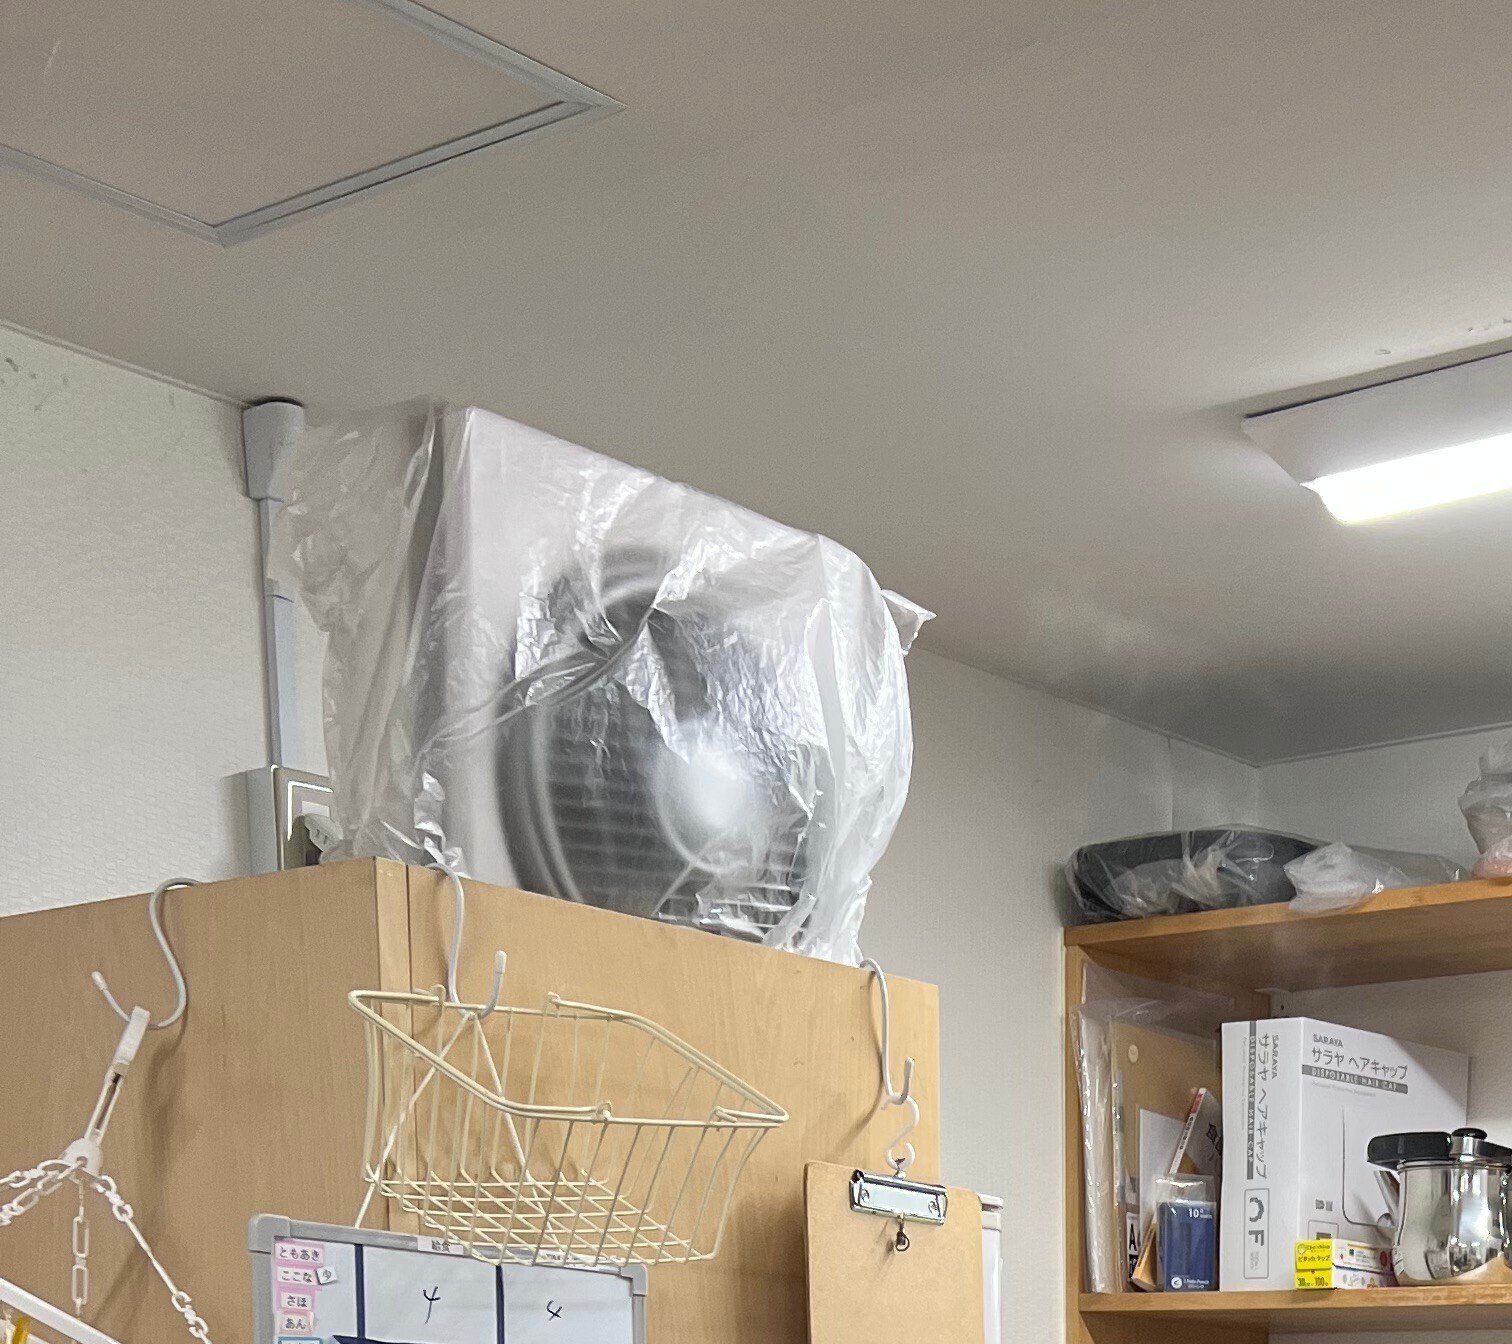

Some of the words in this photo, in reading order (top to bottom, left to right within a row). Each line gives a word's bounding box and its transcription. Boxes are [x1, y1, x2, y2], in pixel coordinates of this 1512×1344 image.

[1313, 1034, 1343, 1048] SARAYA
[1258, 1033, 1269, 1081] サラヤ
[1312, 1047, 1344, 1067] サラヤ
[1349, 1056, 1408, 1080] ヘアキャップ
[1256, 1088, 1268, 1179] ヘアキャップ
[280, 1248, 319, 1261] ともあき
[282, 1270, 312, 1283] ここな
[287, 1295, 307, 1307] さほ
[285, 1318, 306, 1330] あん
